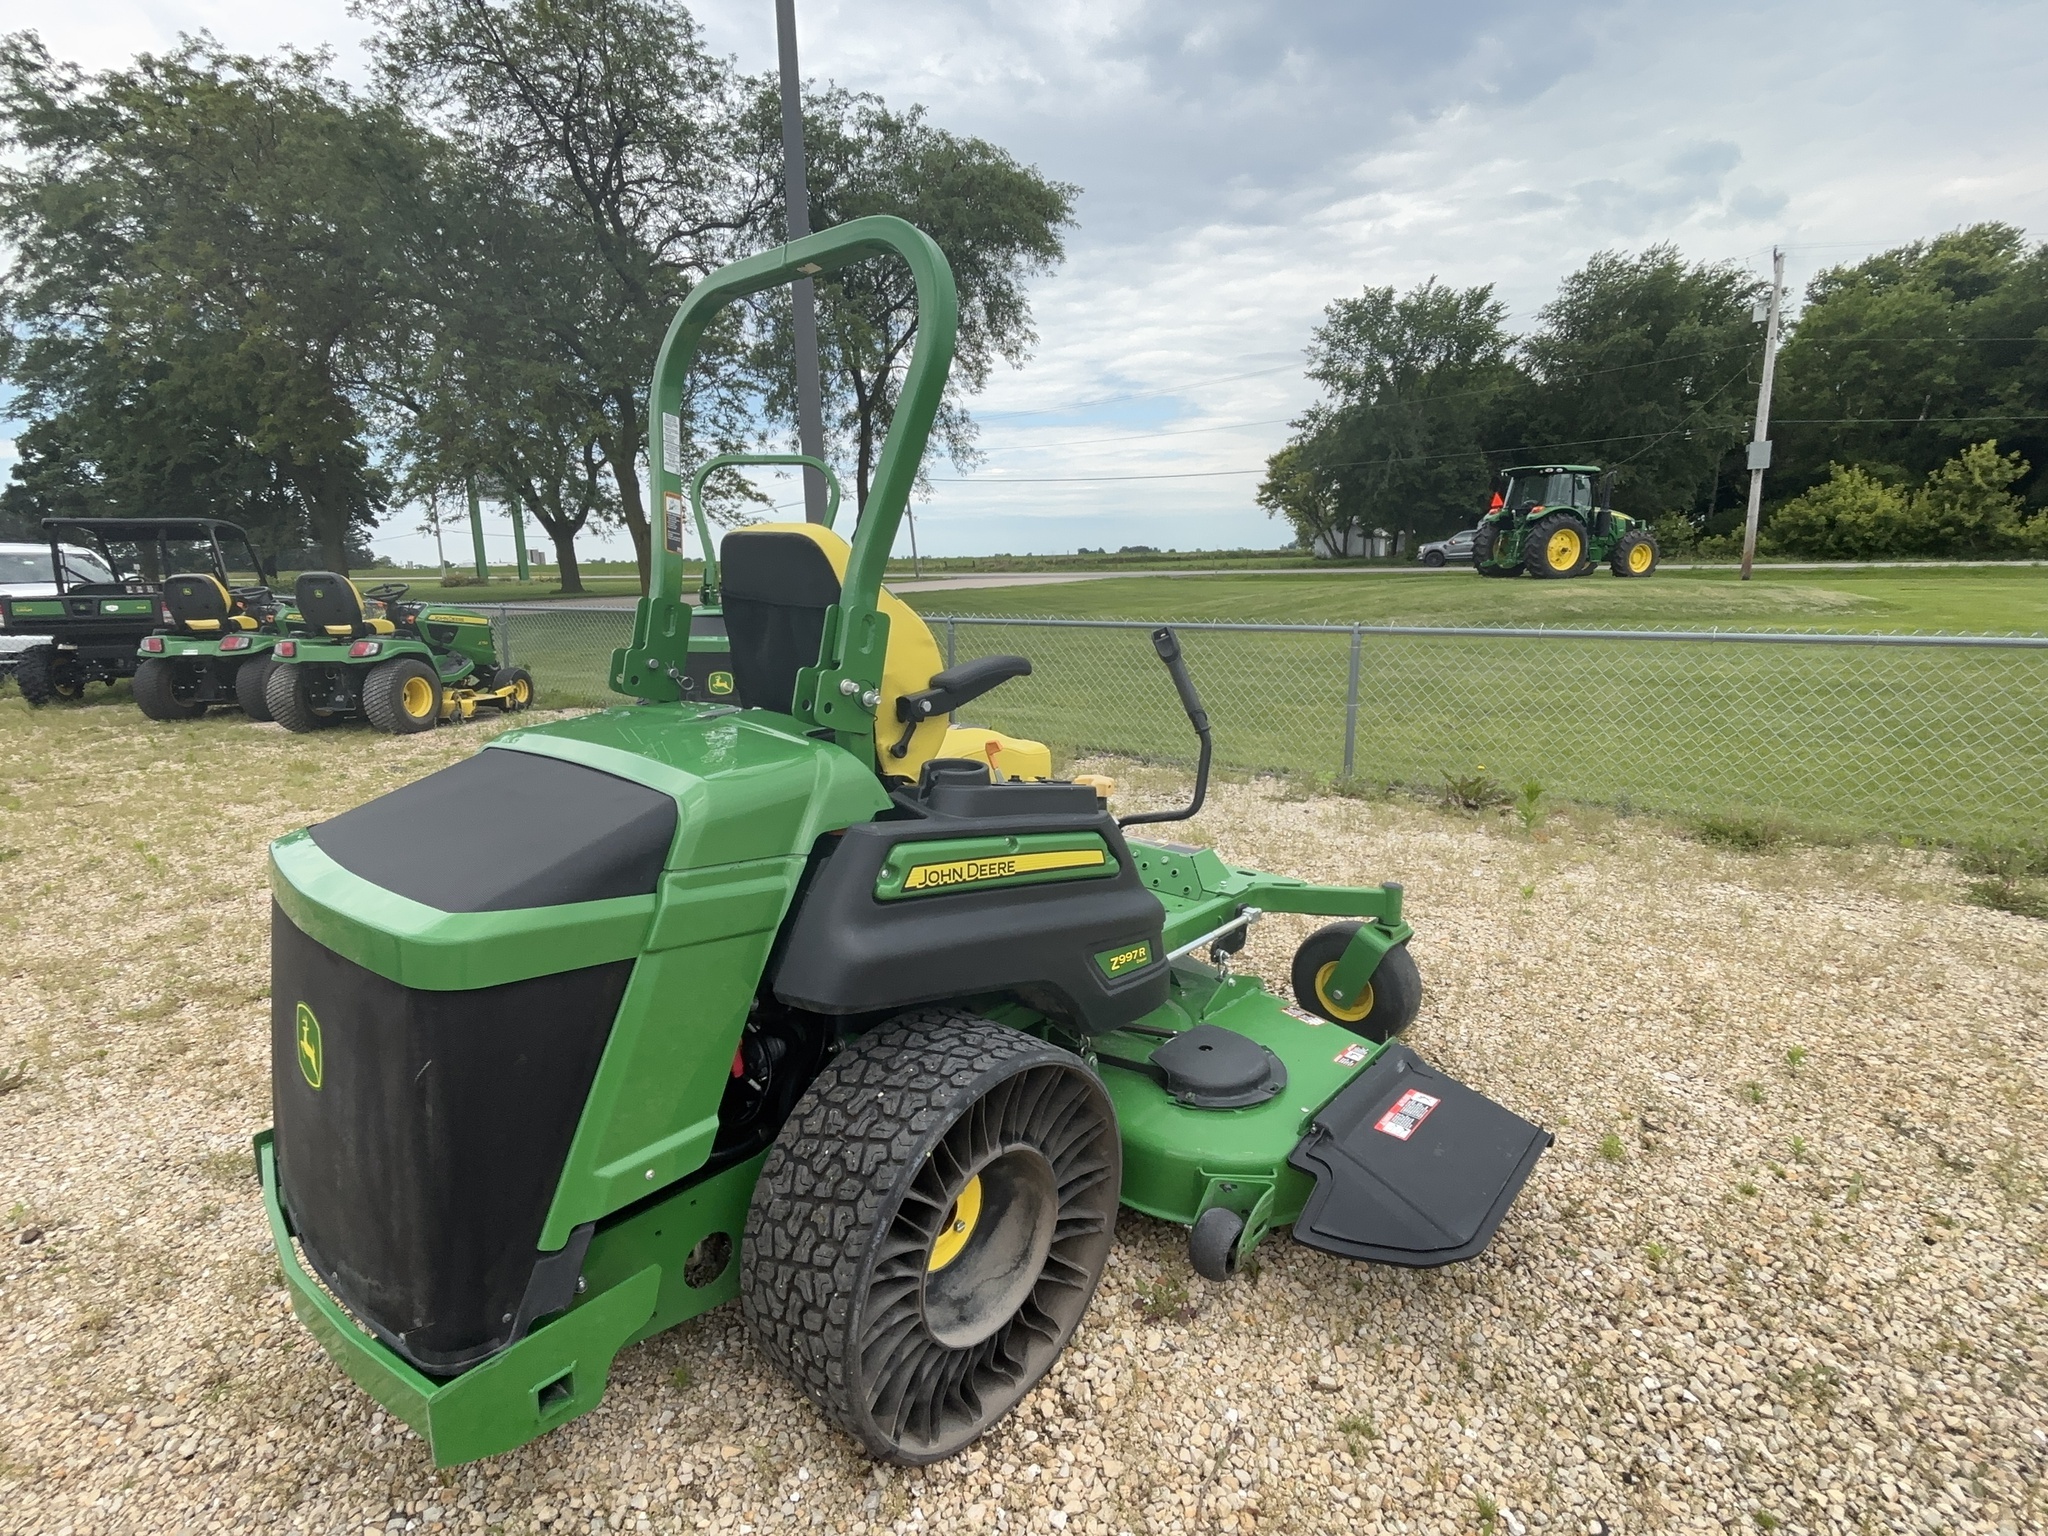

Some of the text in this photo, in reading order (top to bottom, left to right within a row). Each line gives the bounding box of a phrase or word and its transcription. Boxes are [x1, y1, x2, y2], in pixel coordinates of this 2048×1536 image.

[918, 861, 1016, 886] JOHN DEERE
[1110, 947, 1146, 971] Z997R
